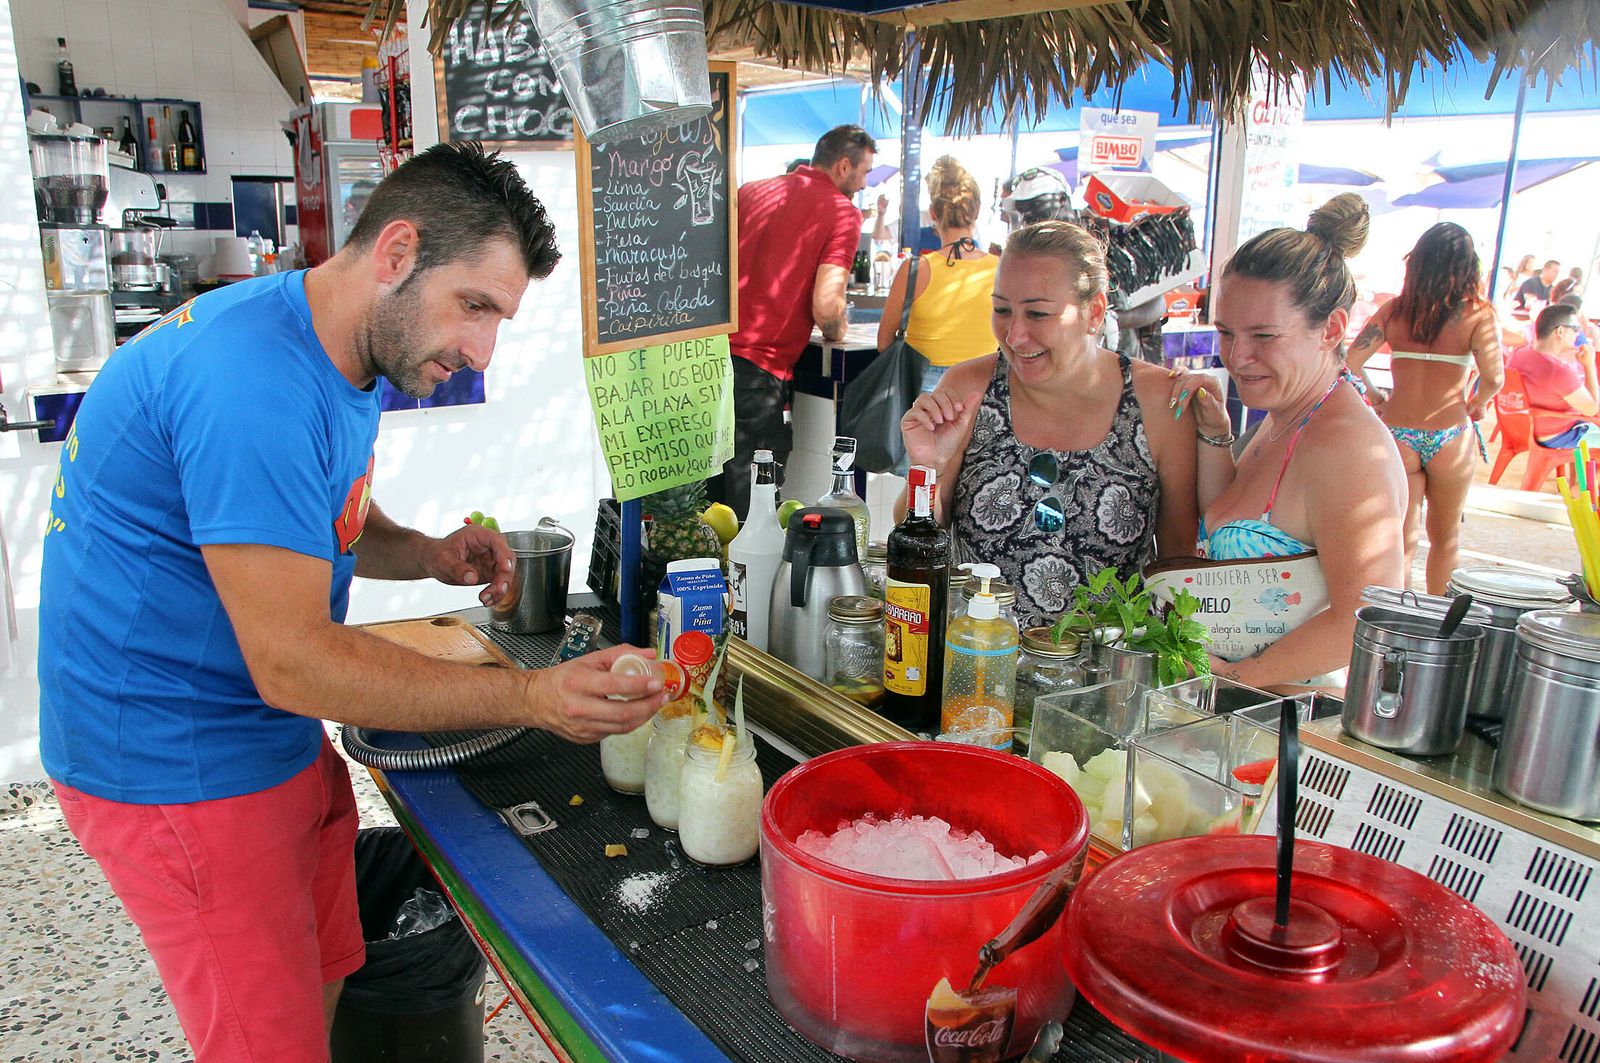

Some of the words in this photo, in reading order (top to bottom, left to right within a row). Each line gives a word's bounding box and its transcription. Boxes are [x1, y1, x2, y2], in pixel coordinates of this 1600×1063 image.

[450, 18, 547, 64] HAB
[1121, 115, 1137, 125] sea
[1096, 141, 1137, 159] BIMBO
[606, 178, 650, 195] Lima
[605, 211, 659, 232] Melón
[606, 265, 650, 287] Frutas
[654, 265, 674, 283] del
[604, 299, 652, 319] Piña
[657, 285, 715, 314] Colada
[591, 355, 616, 382] NO
[628, 350, 647, 371] SE
[663, 338, 716, 364] PUEDE
[594, 377, 654, 408] BAJAR
[662, 367, 689, 390] LOS
[642, 393, 693, 419] PLAYA
[699, 383, 726, 404] SIN
[605, 431, 627, 452] MI
[637, 411, 712, 443] EXPRESO
[617, 474, 635, 489] LO
[640, 463, 685, 485] ROBAN
[692, 583, 724, 591] Exprimido
[1197, 569, 1250, 586] QUISIERA
[1258, 568, 1279, 584] SER
[692, 604, 713, 612] Zumo
[887, 603, 922, 624] BARREIRO
[693, 618, 712, 626] Piña
[1245, 623, 1260, 634] tan
[1265, 622, 1285, 634] local
